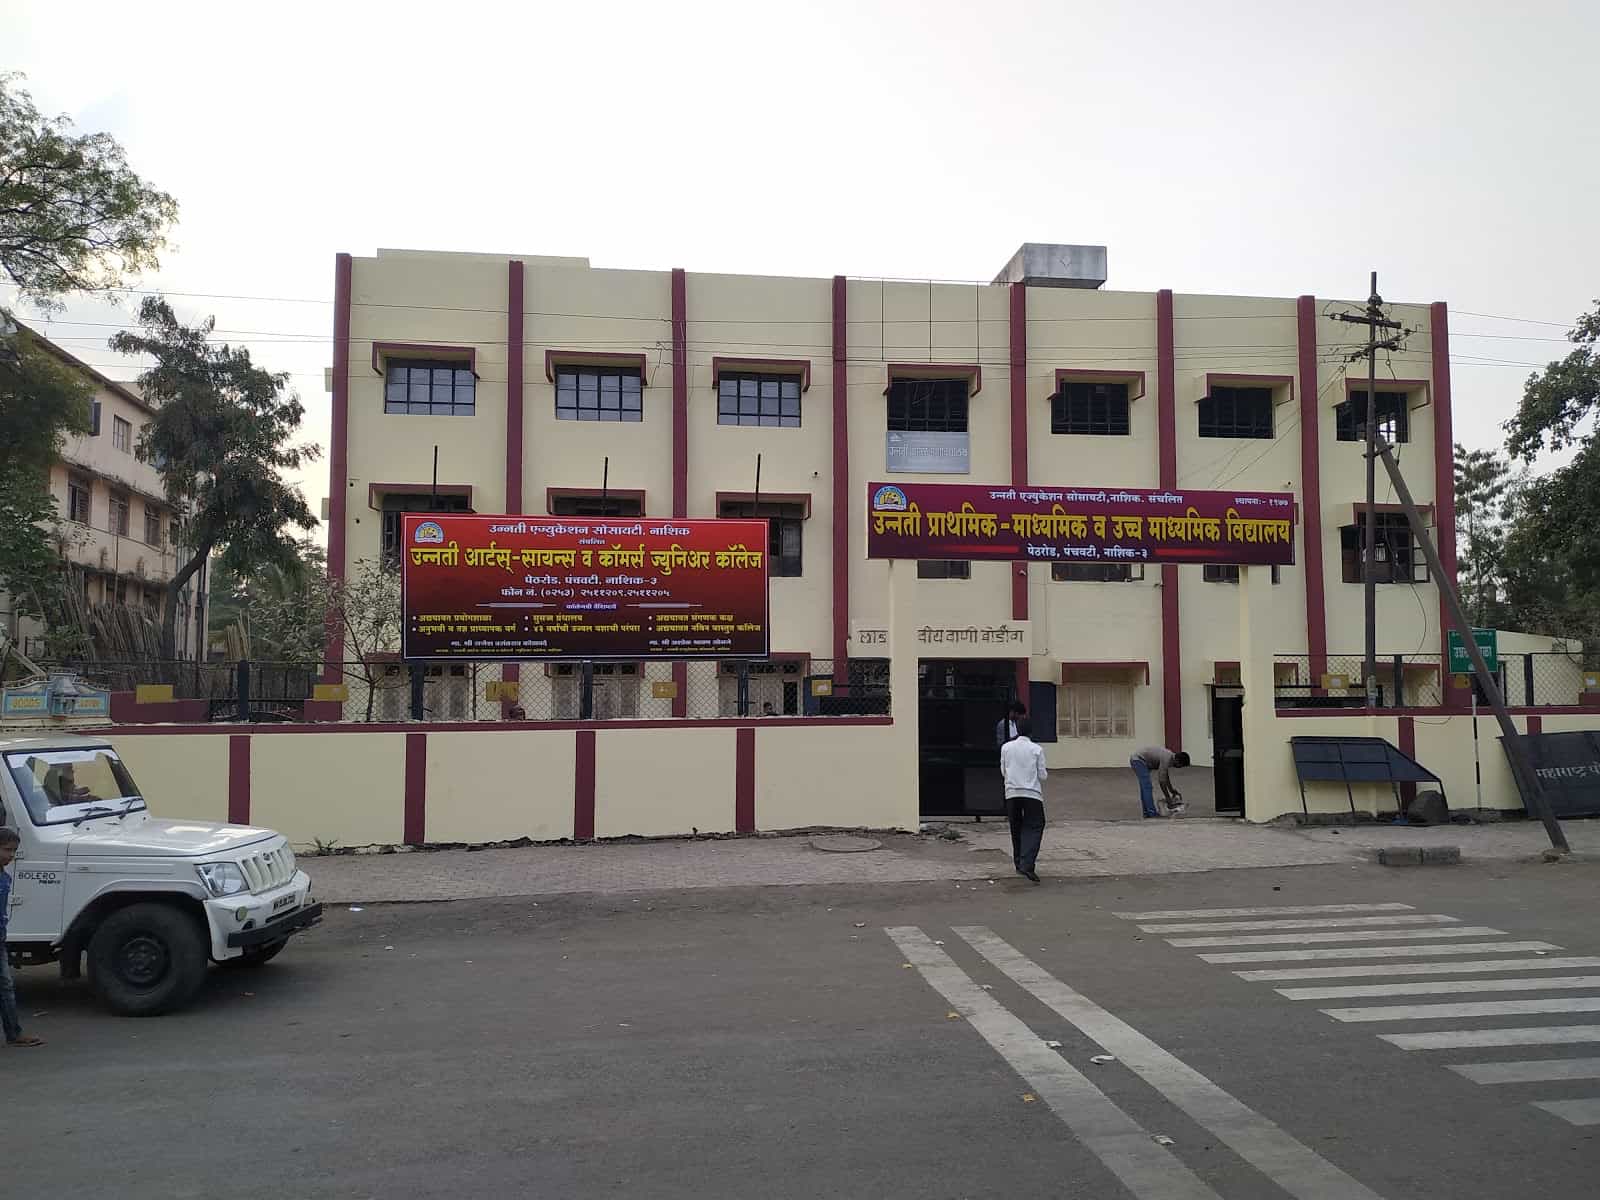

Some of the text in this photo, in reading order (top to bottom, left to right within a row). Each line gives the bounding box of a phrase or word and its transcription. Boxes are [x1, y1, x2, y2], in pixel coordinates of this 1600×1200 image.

[989, 489, 1016, 500] उन्नती
[1019, 490, 1062, 503] एज्युकेशन
[1148, 491, 1183, 504] संचलित
[488, 522, 526, 535] उन्नती
[530, 522, 589, 538] एज्युकेशन
[650, 523, 691, 536] नाशिक
[872, 503, 921, 537] उन्नती
[1092, 514, 1107, 541] व
[1111, 515, 1143, 542] उच्च
[1147, 506, 1221, 543] माध्यमिक
[1225, 507, 1292, 545] विद्यालय
[410, 541, 460, 567] उन्नती
[581, 549, 593, 568] व
[598, 544, 645, 569] कॉमर्स
[650, 544, 711, 575] ज्युनिअर
[715, 544, 763, 569] कॉलेज
[1026, 543, 1148, 558] पेठरोड, पंचवटी, नाशिक-३
[605, 574, 657, 585] नाशिक-३
[501, 587, 523, 597] फोन
[525, 587, 537, 597] नं.
[541, 587, 575, 598] (०२५३)
[946, 626, 978, 643] वाणी
[18, 872, 56, 880] BOLERO
